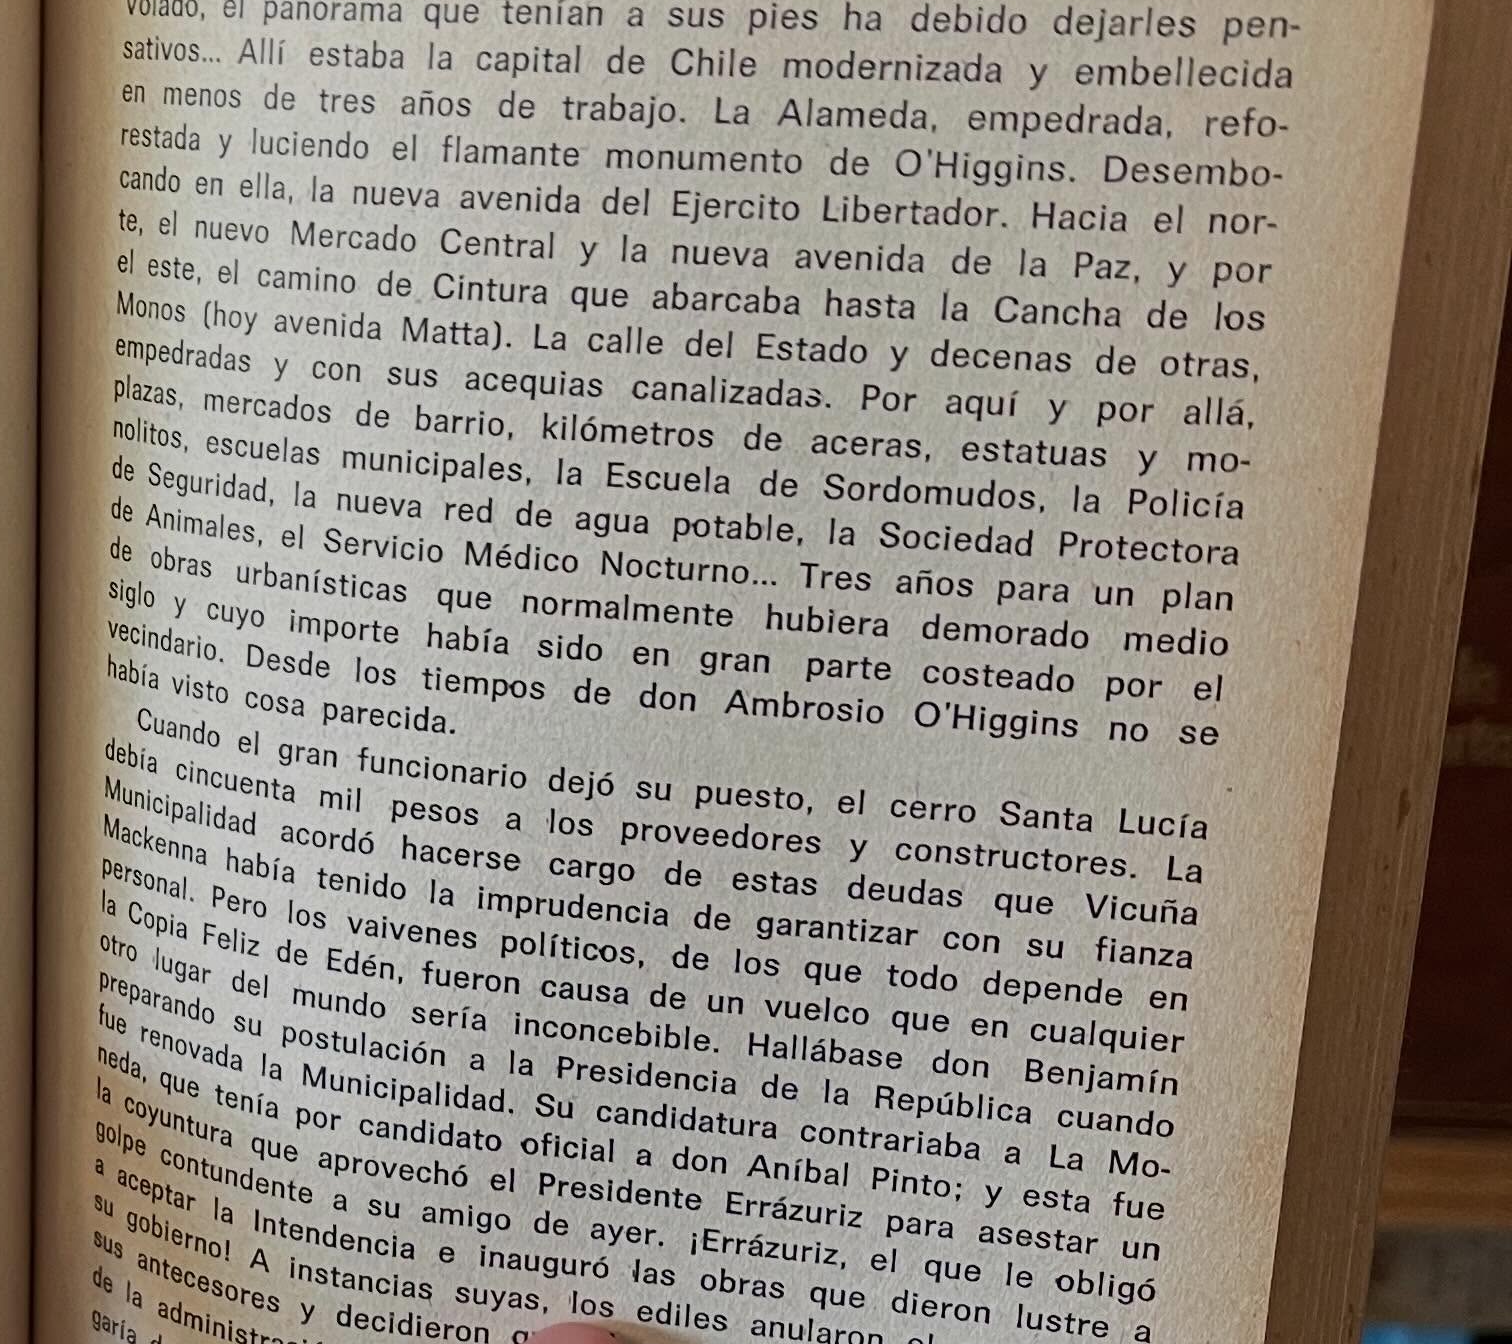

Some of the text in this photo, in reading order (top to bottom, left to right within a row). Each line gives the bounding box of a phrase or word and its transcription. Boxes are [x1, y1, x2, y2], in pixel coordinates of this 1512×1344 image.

[121, 36, 1294, 92] sativos... Allí estaba la capital de Chile modernizada y embellecida
[115, 288, 1260, 385] Monos (hoy avenida Matta). La calle del Estado y decenas de otras,
[106, 619, 1221, 747] vecindario. Desde los tiempos de don Ambrosio O'Higgins no se
[136, 706, 1209, 842] Cuando el gran funcionario dejó su puesto, el cerro Santa Lucía
[98, 970, 1176, 1139] preparando su postulación a la Presidencia de la República cuando
